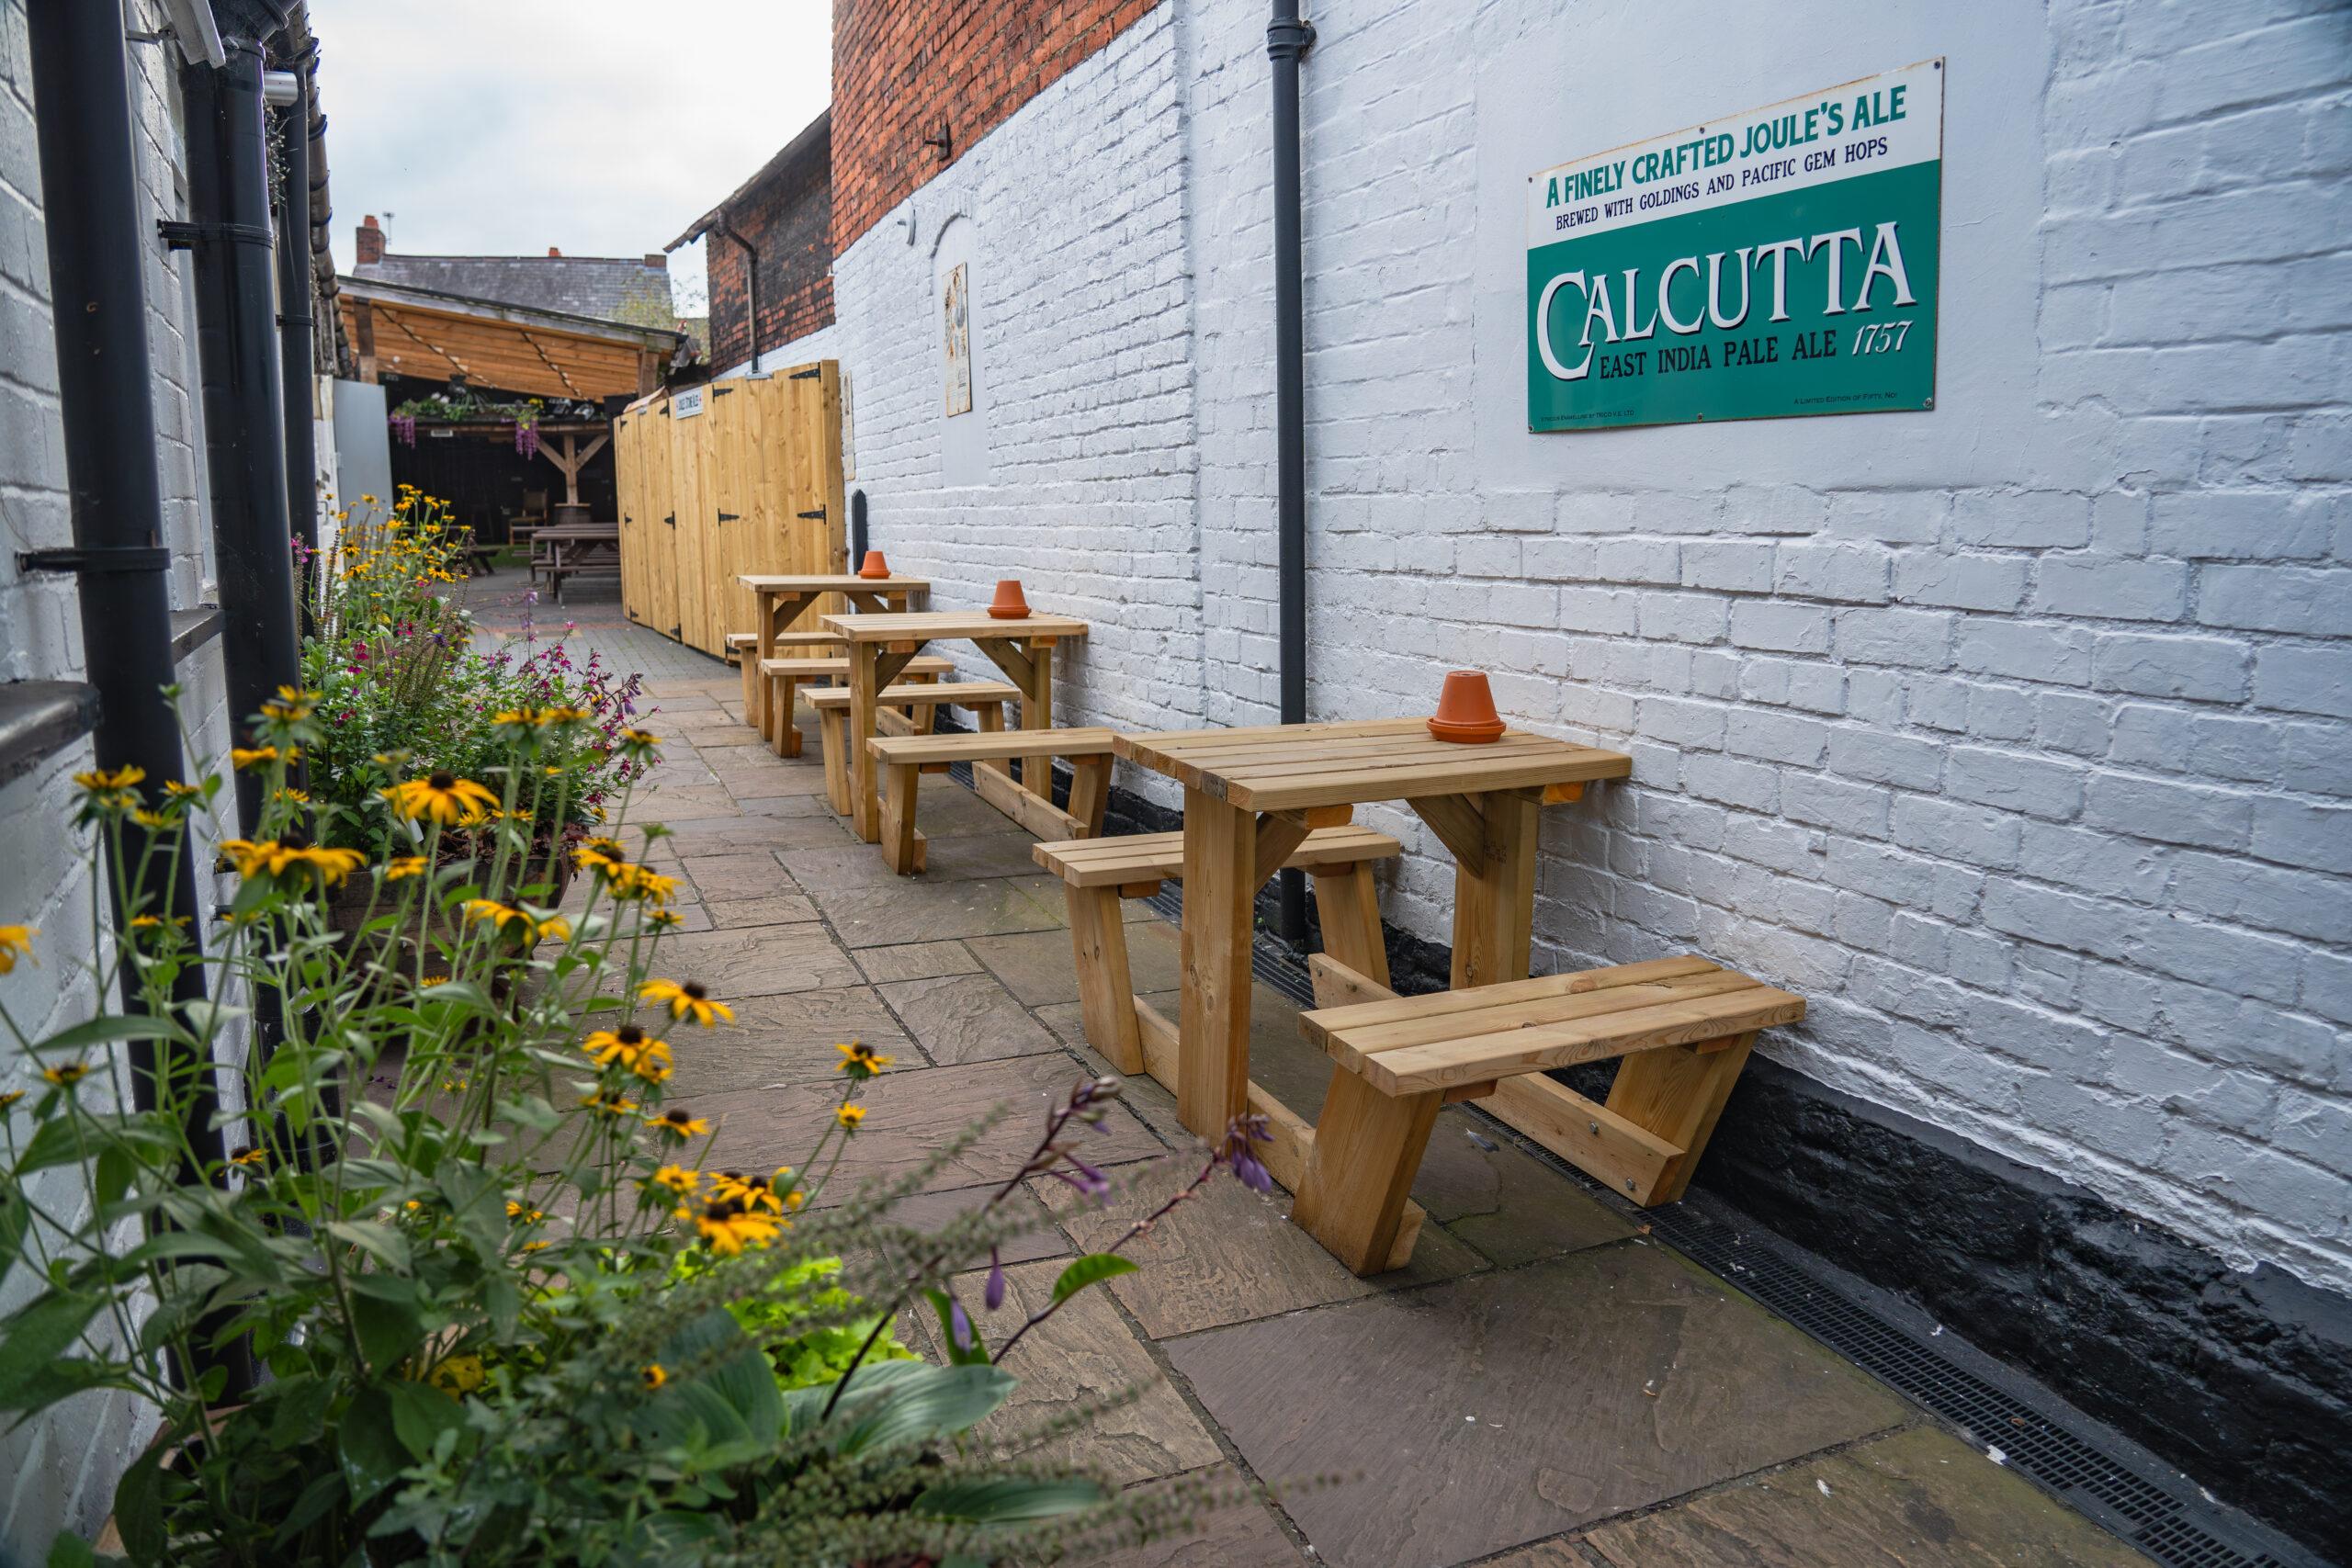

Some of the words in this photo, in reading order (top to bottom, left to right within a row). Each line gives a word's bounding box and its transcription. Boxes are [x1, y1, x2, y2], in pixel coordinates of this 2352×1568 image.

[1546, 177, 1560, 209] A
[1565, 160, 1626, 204] FINELY
[1632, 132, 1735, 185] CRAFTED
[1740, 101, 1844, 159] JOULE'S
[1851, 85, 1906, 131] ALE
[1556, 207, 1598, 231] BREWED
[1604, 197, 1633, 219] WITH
[1639, 181, 1700, 210] GOLDINGS
[1706, 174, 1735, 196] AND
[1742, 158, 1796, 187] PACIFIC
[1804, 148, 1836, 173] GEM
[1844, 137, 1888, 164] HOPS
[1536, 220, 1917, 382] CALCUTTA
[1600, 351, 1646, 379] EAST
[1657, 344, 1712, 375] INDIA
[1724, 336, 1779, 367] PALE
[1792, 330, 1837, 361] ALE
[1852, 320, 1913, 356] 1757
[1826, 395, 1851, 403] EDITION
